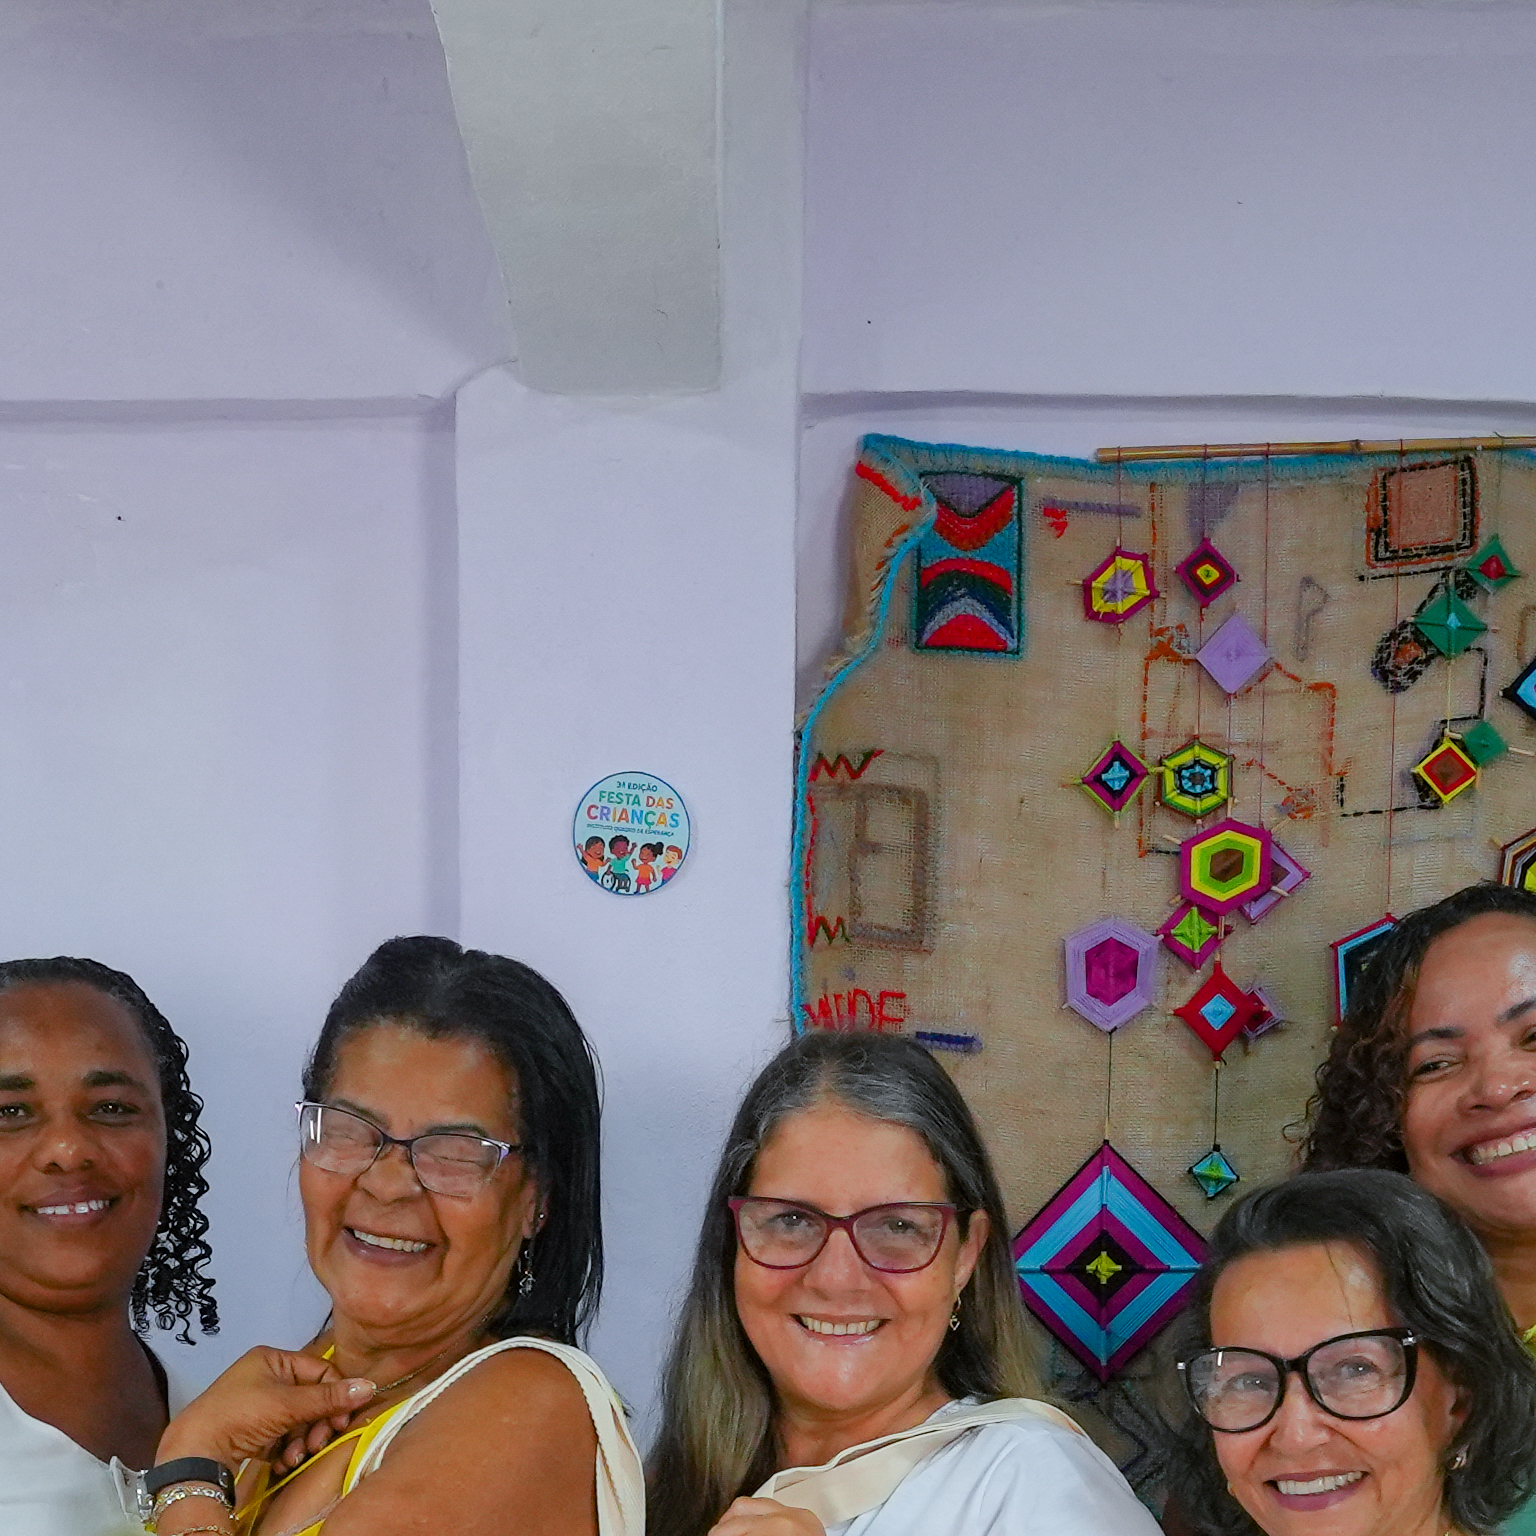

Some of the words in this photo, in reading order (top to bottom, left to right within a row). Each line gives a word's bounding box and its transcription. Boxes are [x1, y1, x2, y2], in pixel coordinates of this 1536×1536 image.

[627, 782, 658, 793] EDIÇÃO
[598, 790, 641, 807] FESTA
[645, 795, 675, 809] DAS
[586, 804, 680, 829] CRIANÇAS
